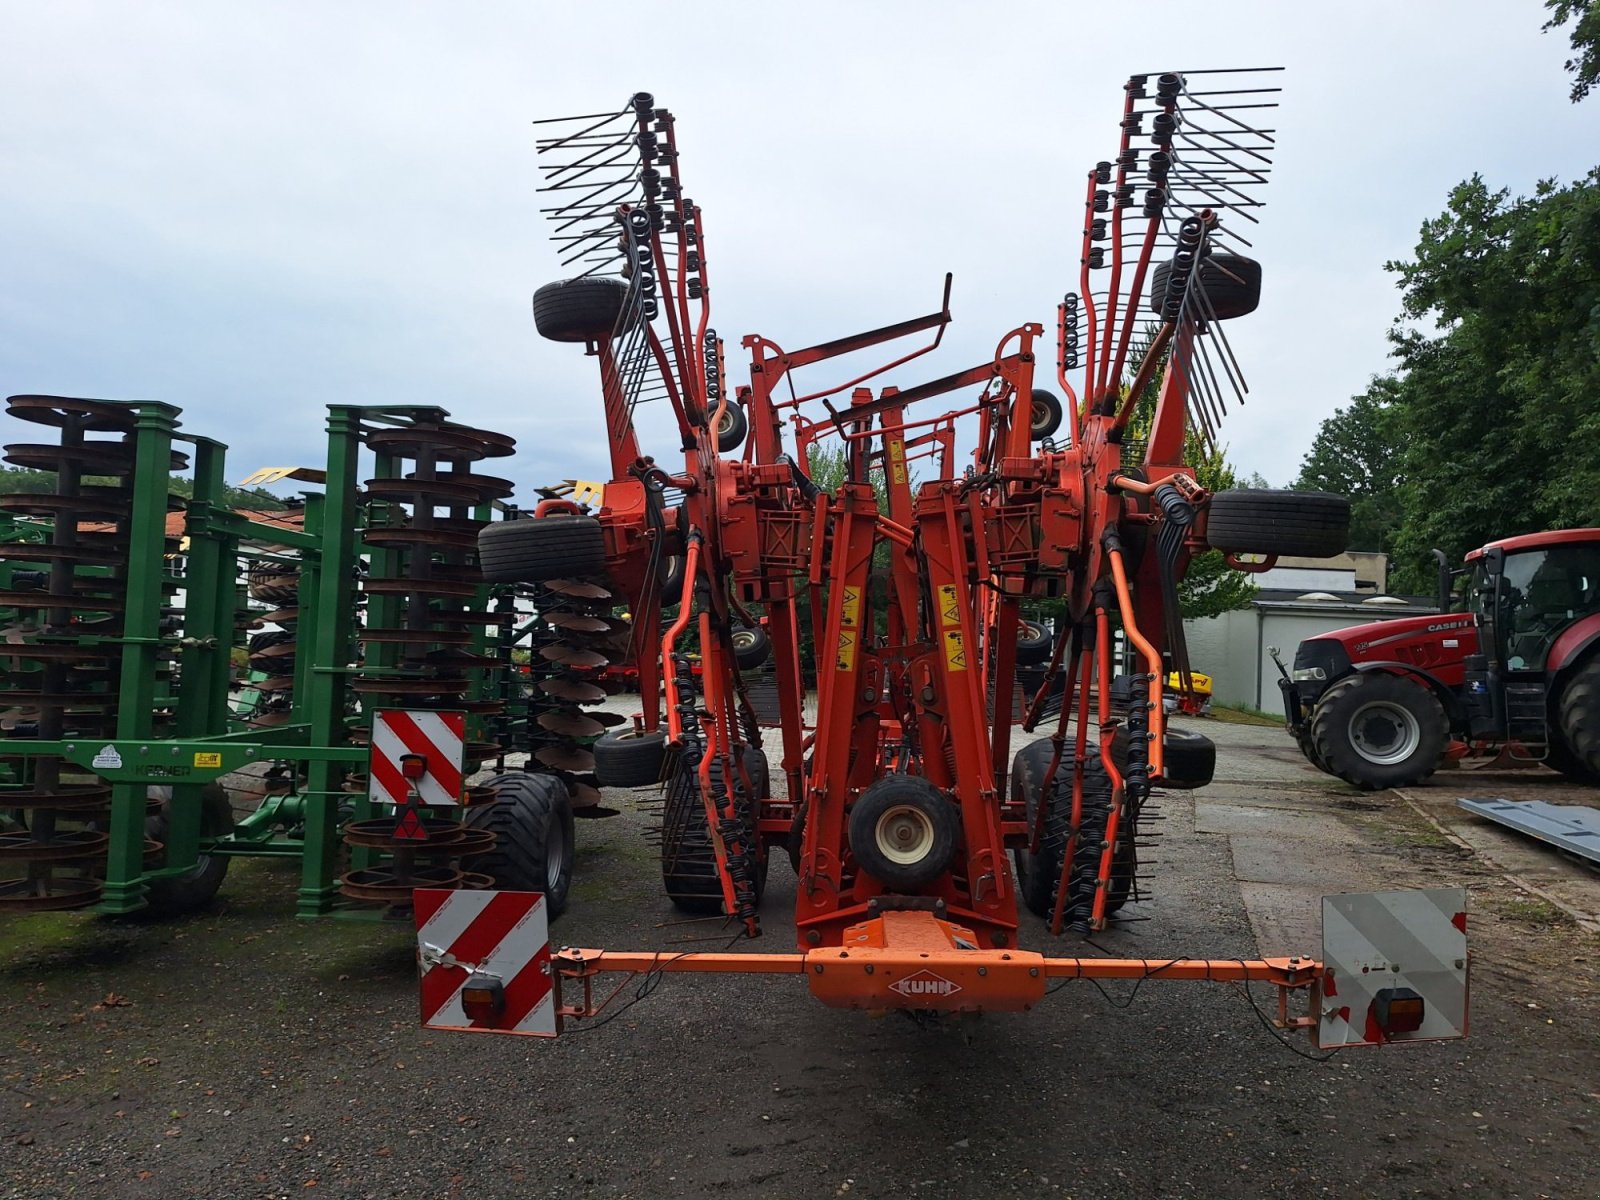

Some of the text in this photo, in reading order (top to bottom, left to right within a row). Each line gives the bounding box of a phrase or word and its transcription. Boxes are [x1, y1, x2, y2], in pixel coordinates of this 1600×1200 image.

[1428, 622, 1457, 631] CASE
[136, 765, 191, 776] KERNER
[899, 980, 951, 994] KUHN
